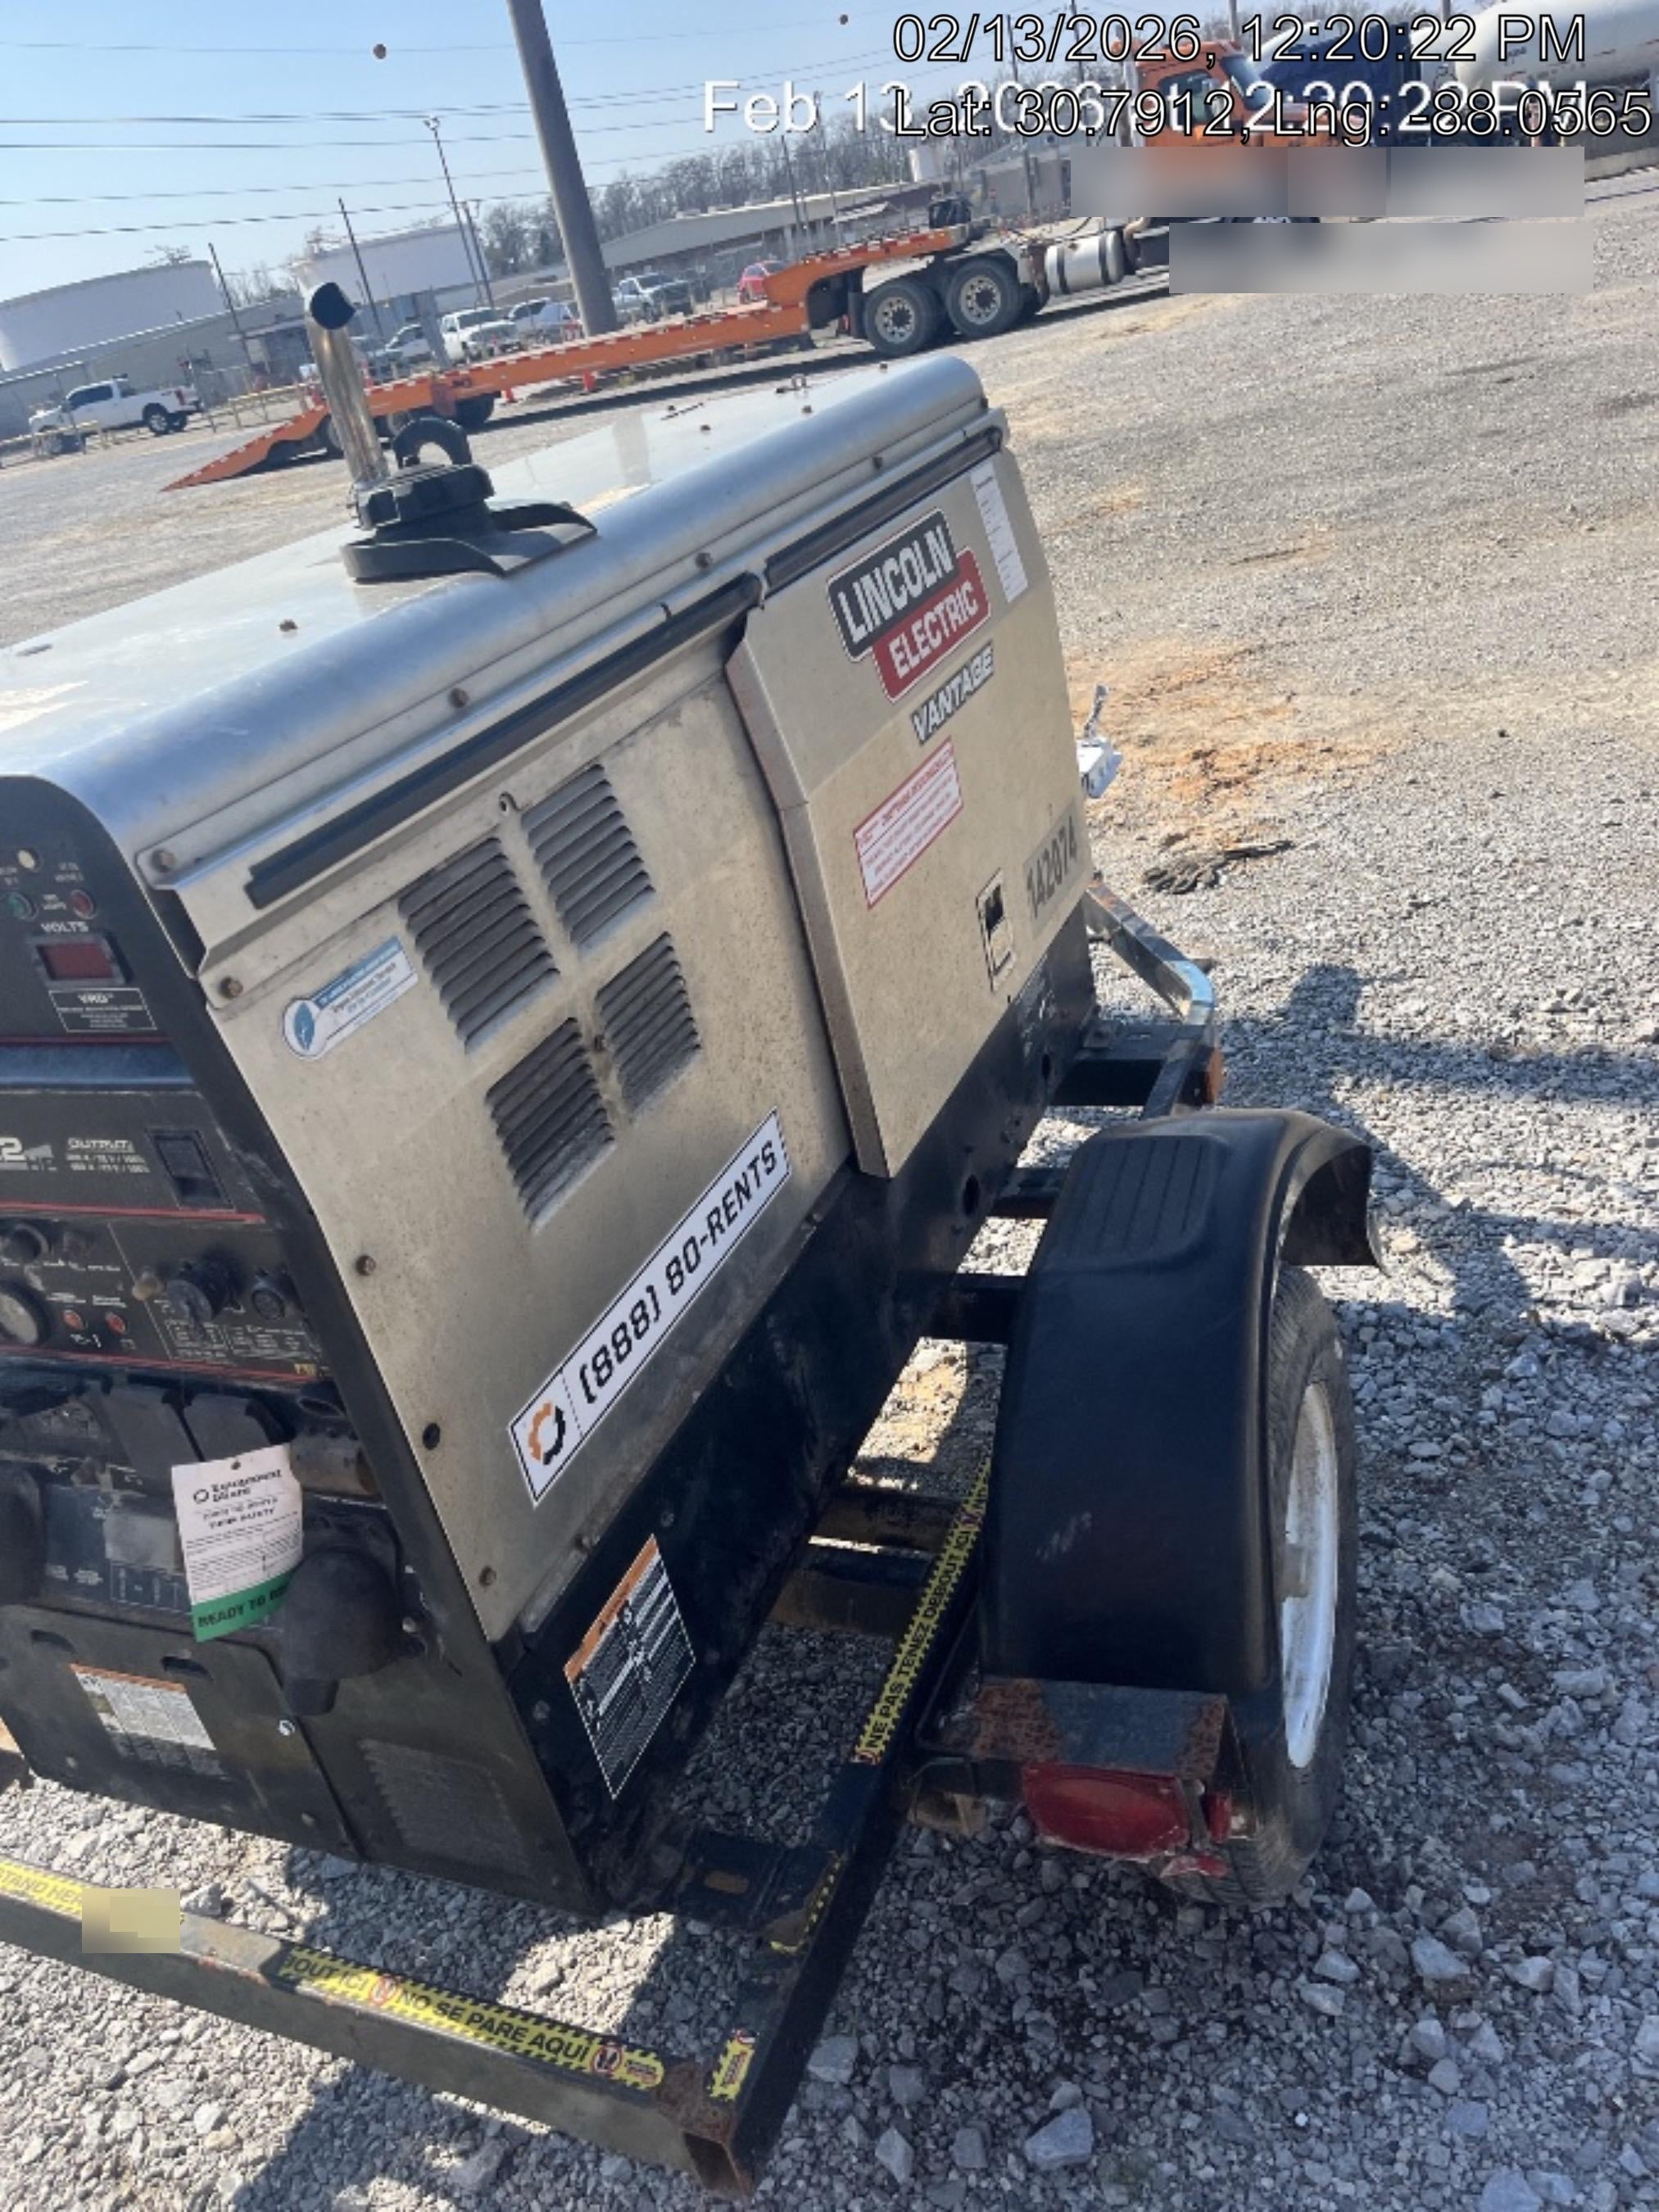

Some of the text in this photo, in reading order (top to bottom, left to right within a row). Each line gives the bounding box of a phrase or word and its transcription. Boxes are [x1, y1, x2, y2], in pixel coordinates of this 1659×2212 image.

[837, 524, 954, 644] LINCOLN
[888, 580, 980, 680] ELECTRIC
[910, 639, 995, 745] VANTAGE
[578, 1139, 778, 1404] (888) 80-RENTS
[865, 1720, 889, 1748] NE
[400, 1989, 432, 2010] NO
[435, 2001, 466, 2021] SE
[465, 2011, 530, 2043] PARE
